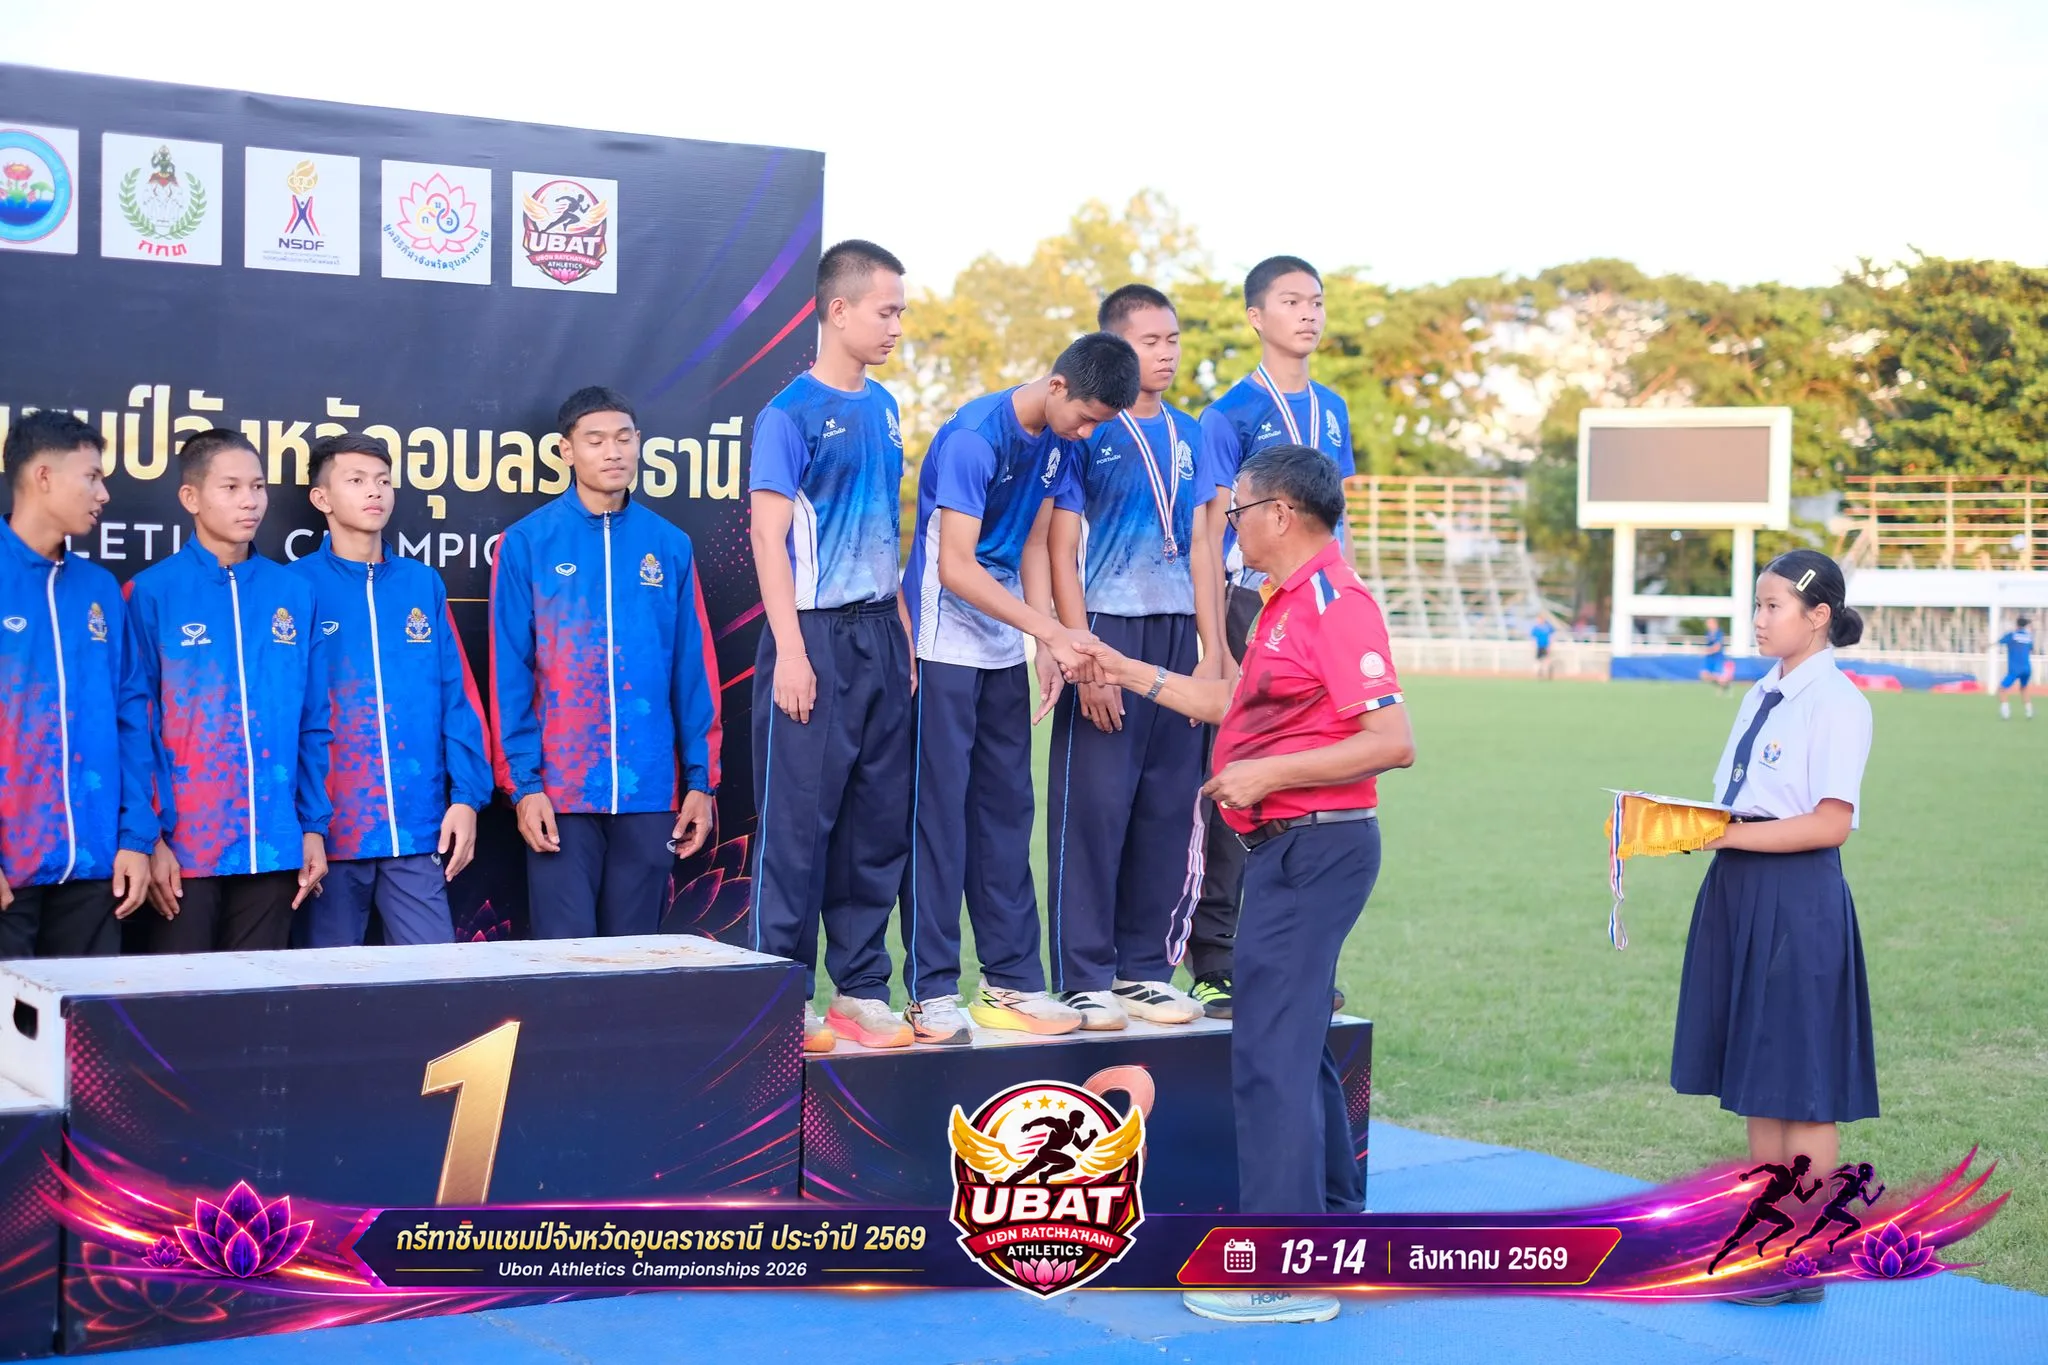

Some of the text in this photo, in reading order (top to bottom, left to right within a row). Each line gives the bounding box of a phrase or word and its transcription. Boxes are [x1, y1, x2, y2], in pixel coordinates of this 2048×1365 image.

[278, 238, 325, 251] NSDF
[528, 231, 602, 256] UBAT
[547, 261, 582, 270] ATHLETICS
[421, 1021, 521, 1206] 1
[1251, 1290, 1292, 1306] HOKA
